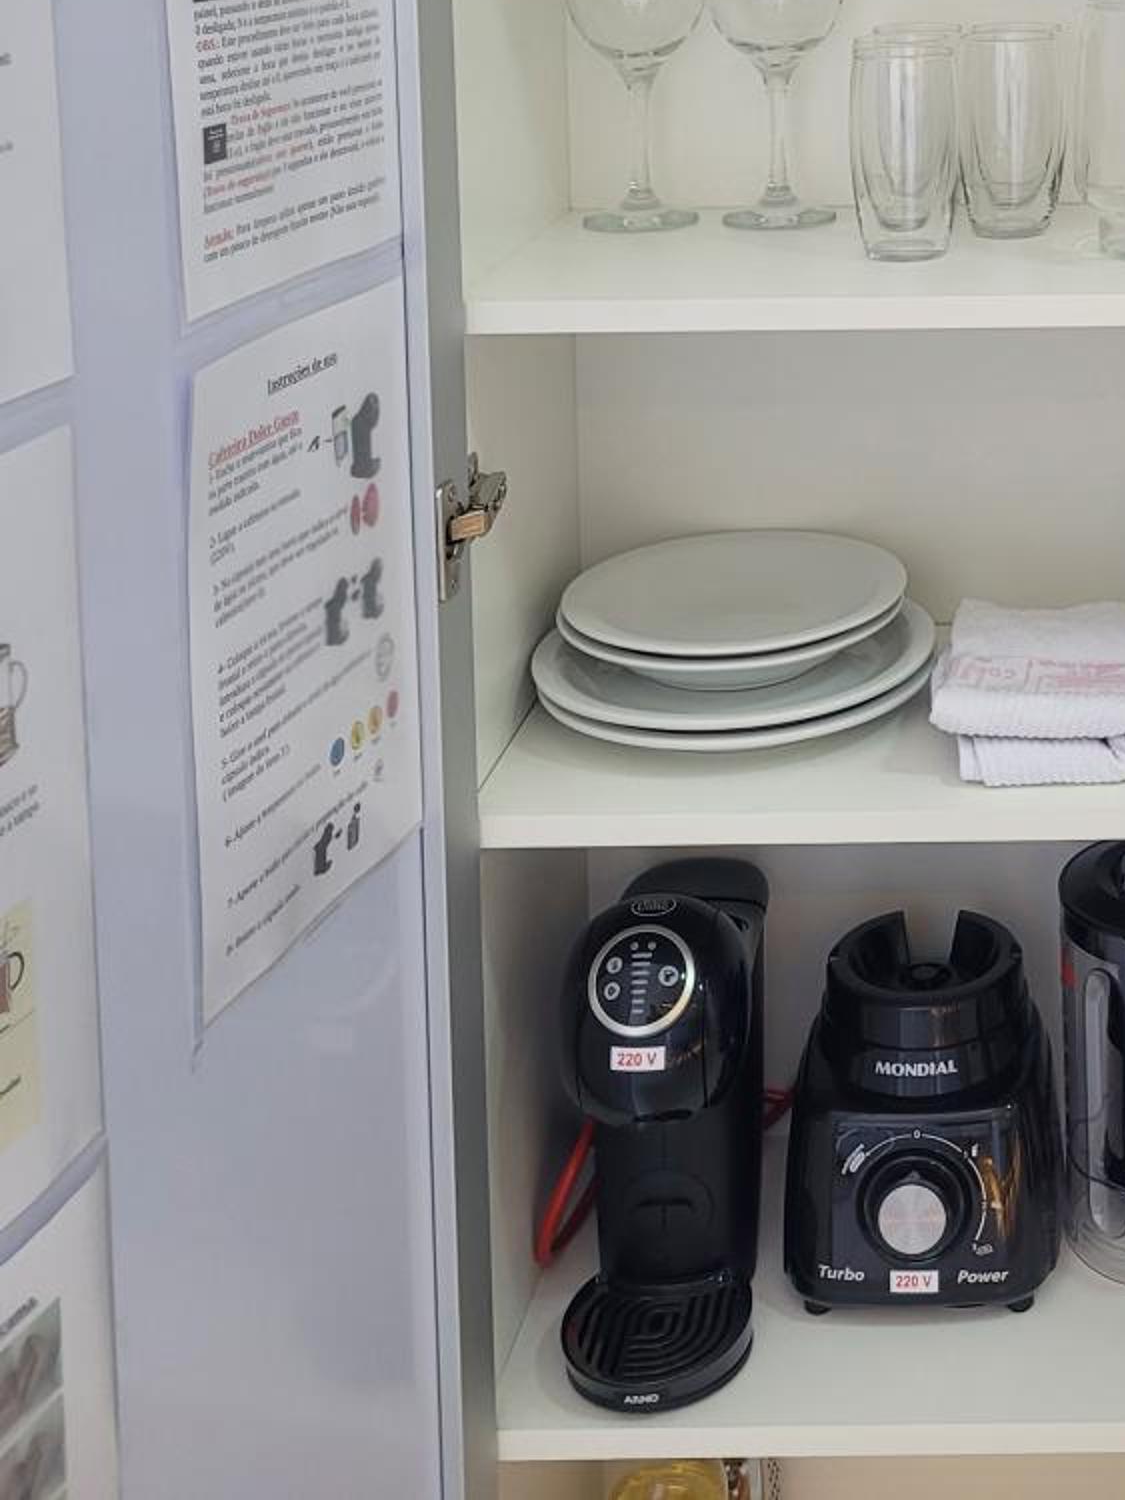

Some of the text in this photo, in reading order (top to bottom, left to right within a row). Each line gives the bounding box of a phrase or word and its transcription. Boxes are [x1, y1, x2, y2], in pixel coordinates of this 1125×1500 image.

[267, 365, 311, 396] Instruções
[312, 357, 322, 372] de
[617, 1052, 657, 1067] 220 V
[875, 1060, 958, 1077] MONDIAL
[818, 1264, 1008, 1288] Turbo 220 V Power
